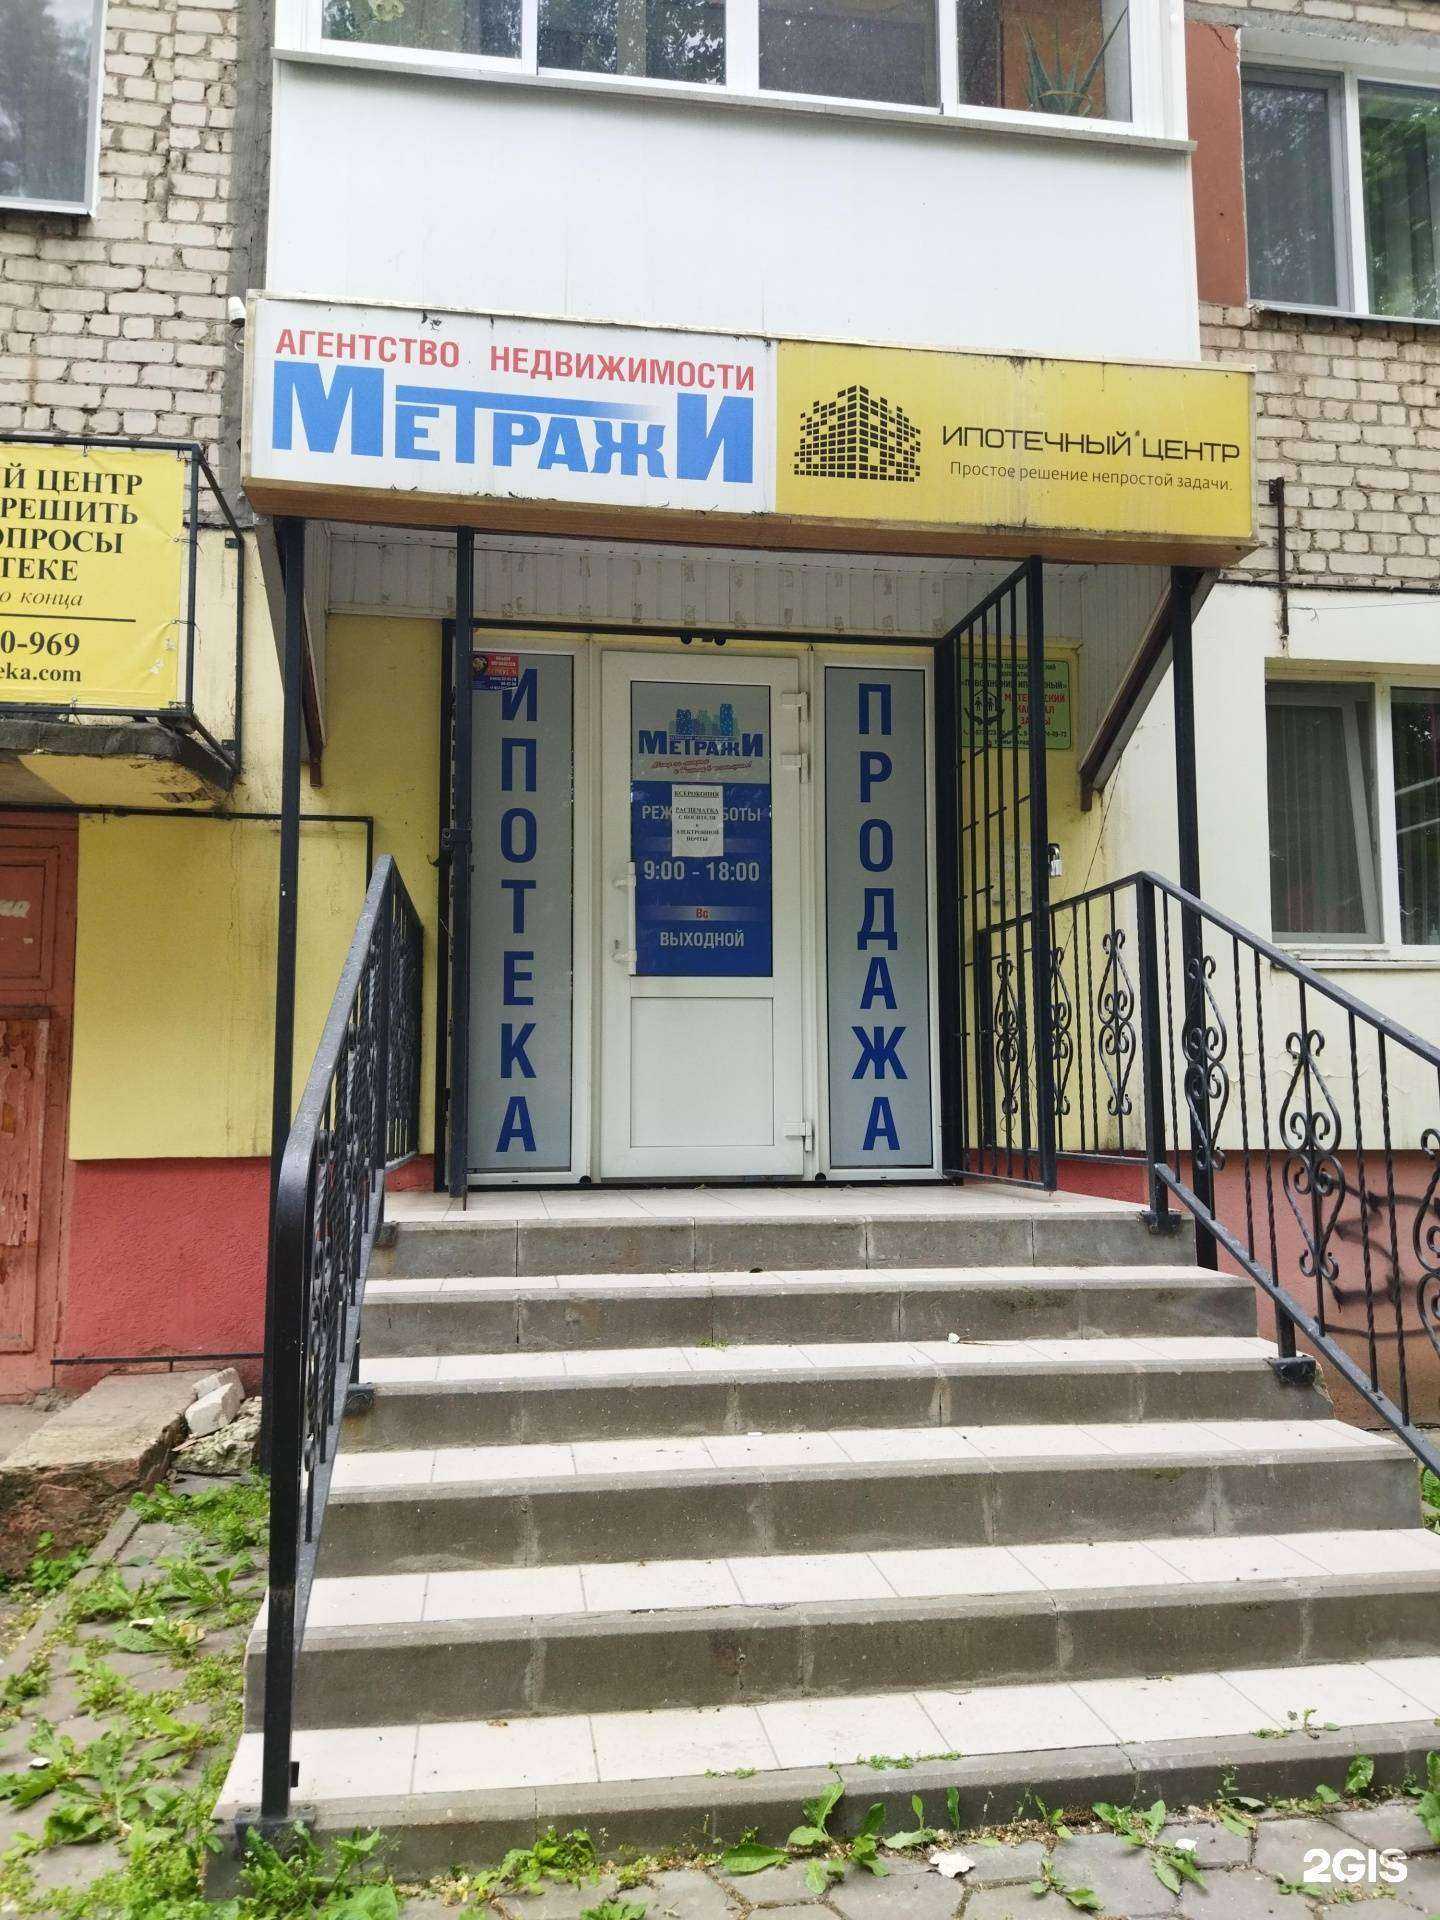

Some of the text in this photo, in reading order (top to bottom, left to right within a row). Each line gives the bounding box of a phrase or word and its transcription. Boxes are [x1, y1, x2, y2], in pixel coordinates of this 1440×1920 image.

[275, 329, 755, 391] АГЕНТСТВО НЕДВИЖИМОСТИ
[272, 360, 754, 483] МЕТРАЖИ
[942, 425, 1240, 463] ИПОТЕЧНЫЙ ЦЕНТР
[37, 469, 143, 496] ЦЕНТР
[950, 460, 1233, 491] Простое решение непростой задачи.
[0, 497, 138, 525] РЕШИТЬ
[20, 591, 83, 610] конца
[0, 630, 80, 656] 0-969
[644, 860, 685, 880] 9:00
[706, 862, 759, 882] 18:00
[496, 668, 539, 1152] ИПОТЕКА
[851, 683, 908, 1151] ПРОДАЖА
[660, 929, 744, 949] ВЫХОДНОЙ
